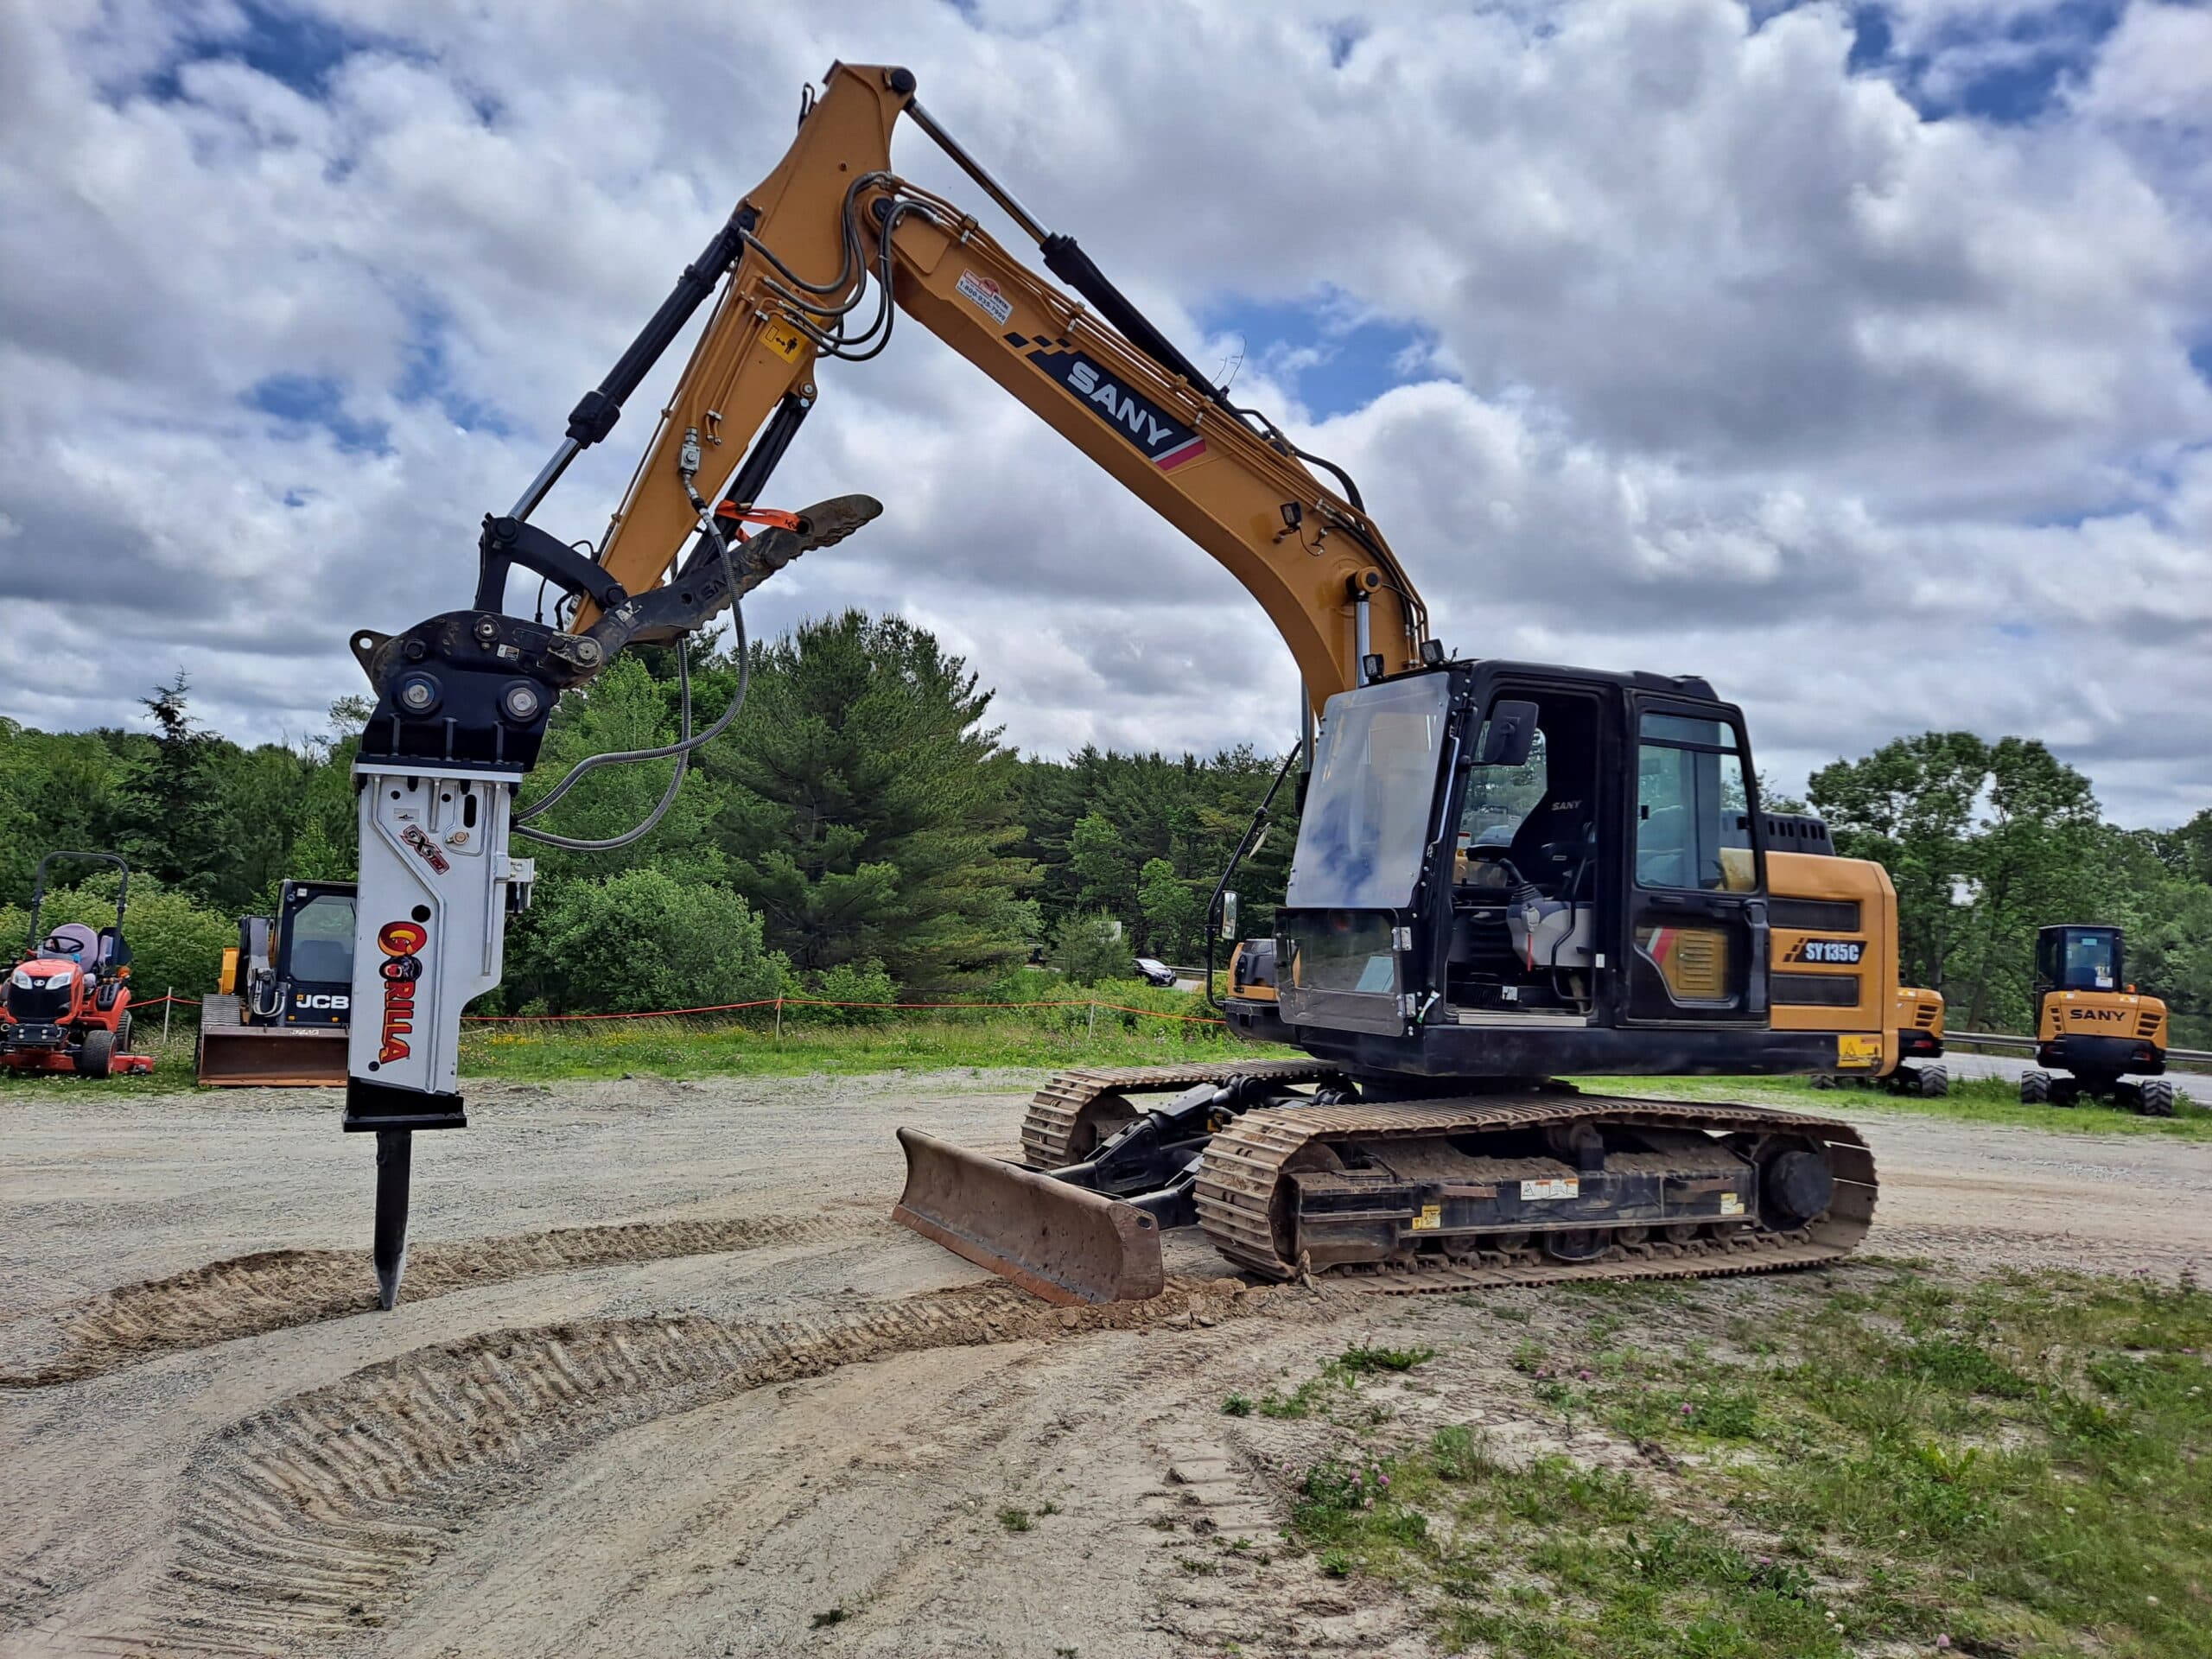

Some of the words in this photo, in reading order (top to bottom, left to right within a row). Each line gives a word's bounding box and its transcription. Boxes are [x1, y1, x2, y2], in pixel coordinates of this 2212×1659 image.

[1067, 361, 1173, 447] SANY
[1551, 800, 1583, 810] SANY
[1805, 942, 1859, 962] SY135C
[296, 994, 350, 1009] JCB
[2070, 1008, 2126, 1021] SANY
